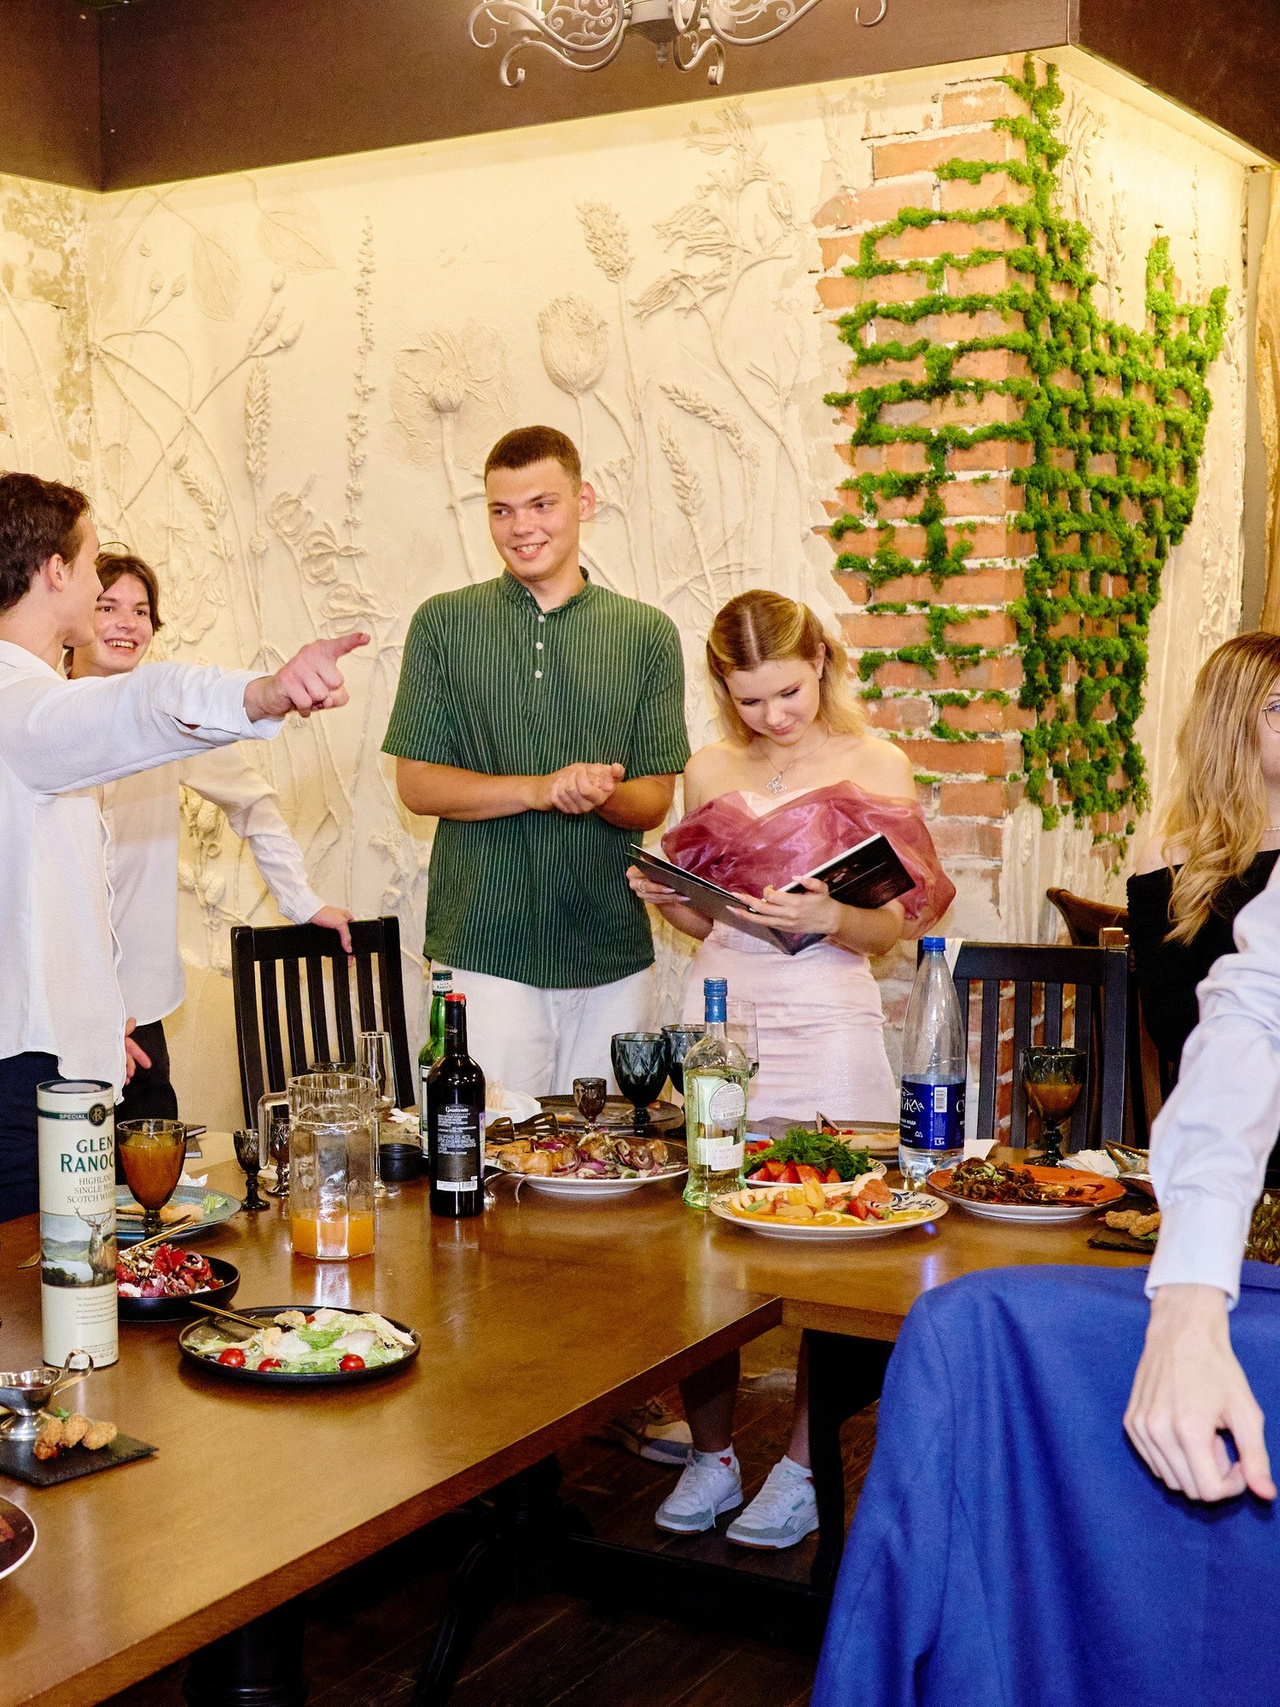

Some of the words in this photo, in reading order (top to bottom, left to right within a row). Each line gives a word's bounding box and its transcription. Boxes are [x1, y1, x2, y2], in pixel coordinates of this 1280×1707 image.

[76, 1135, 113, 1153] GLEN
[73, 1185, 103, 1195] SINGLE
[66, 1194, 99, 1204] SCOTCH
